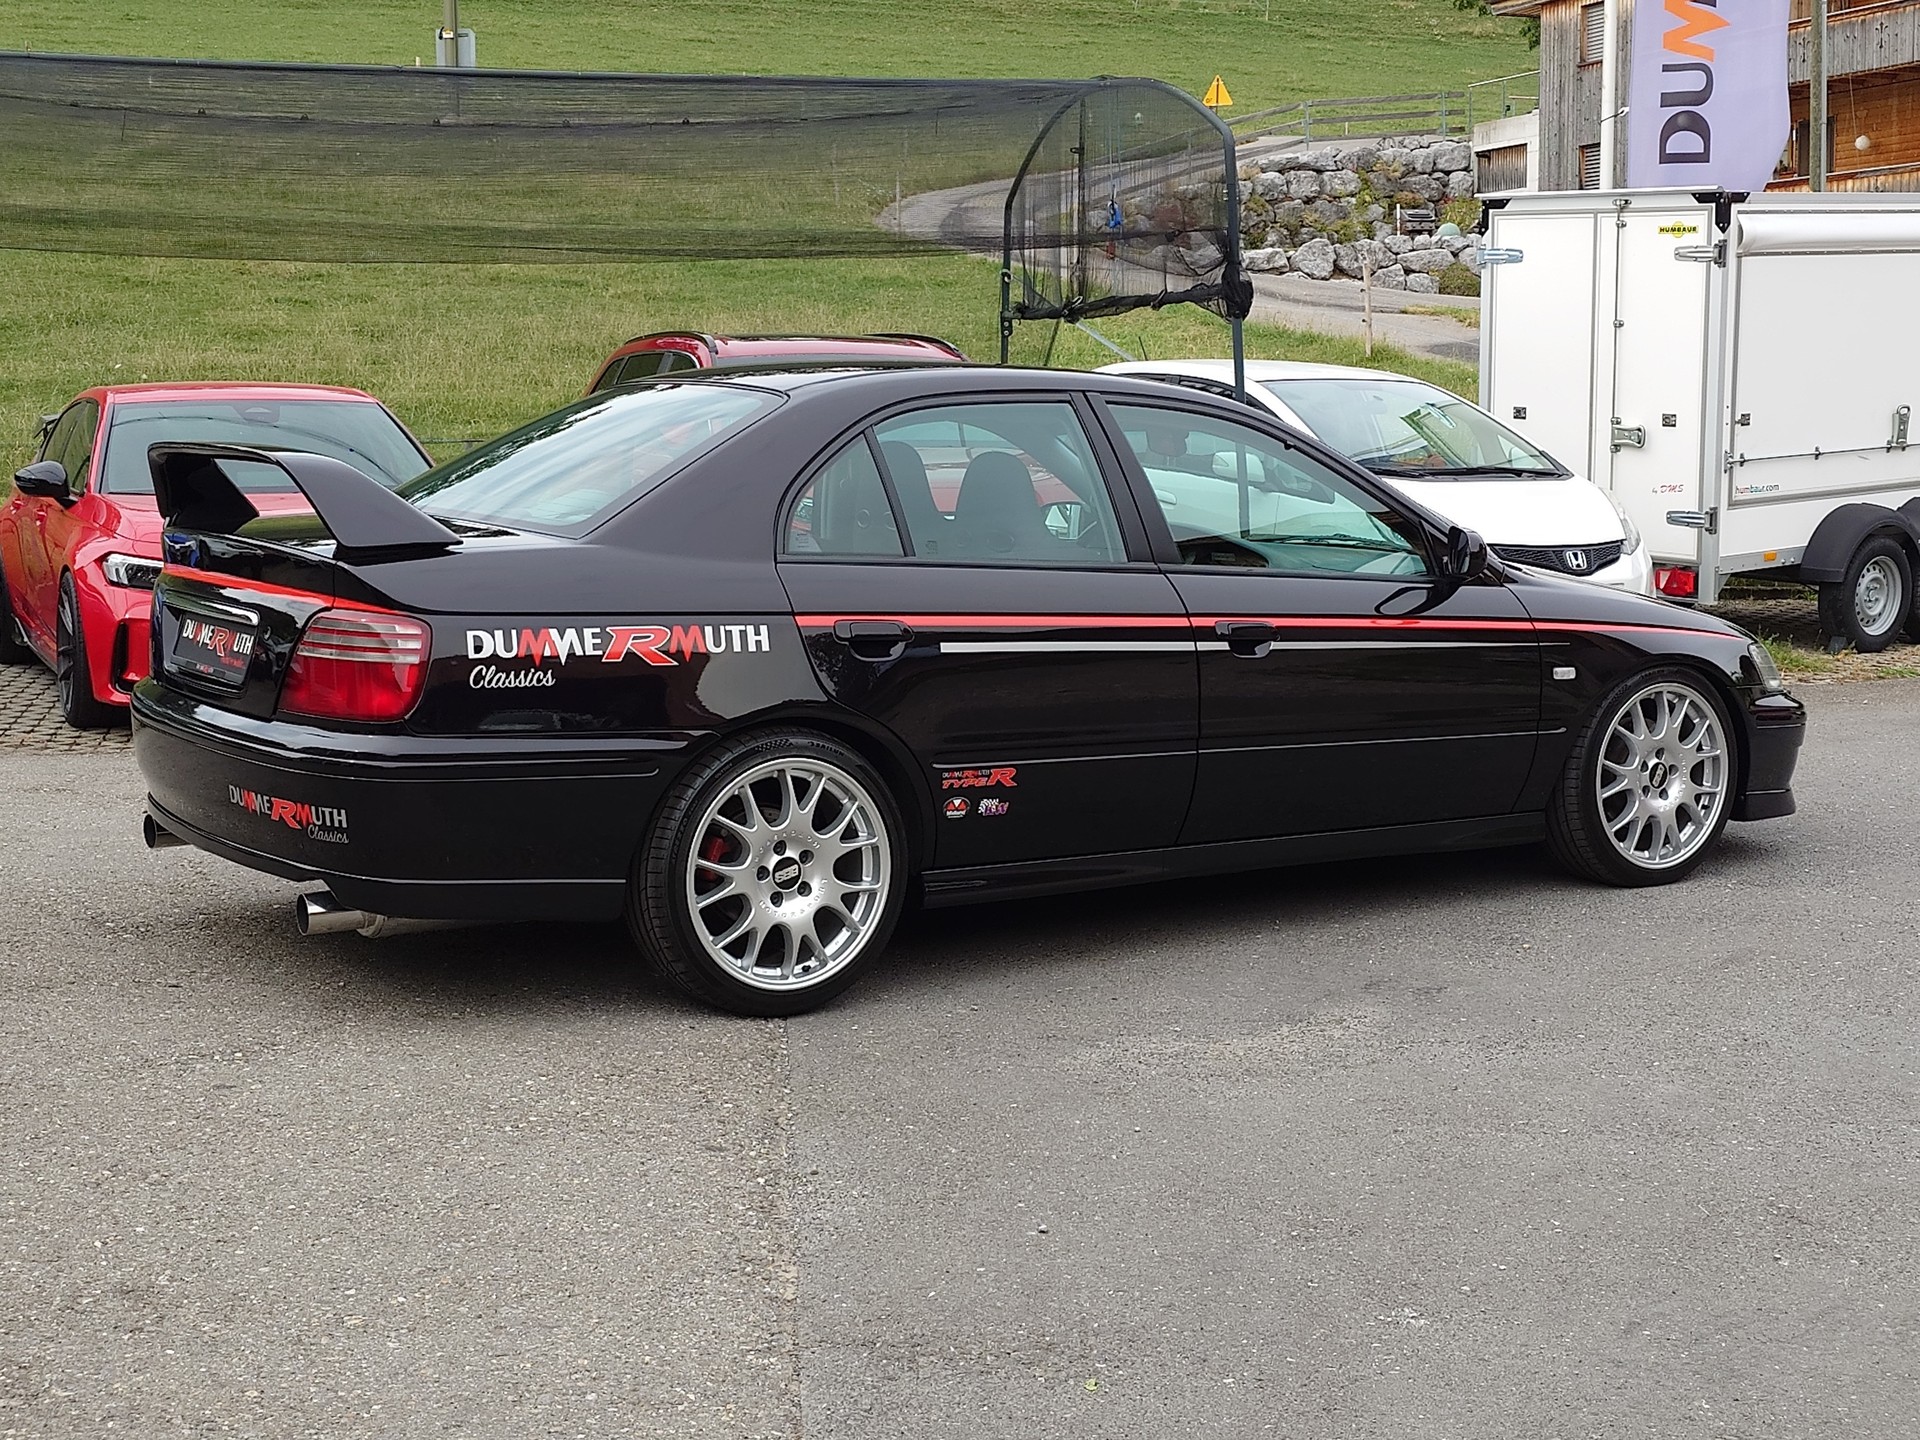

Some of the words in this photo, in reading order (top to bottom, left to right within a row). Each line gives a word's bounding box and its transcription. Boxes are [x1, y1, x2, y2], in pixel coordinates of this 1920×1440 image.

[1659, 0, 1732, 165] DUM
[1735, 484, 1779, 495] humbaur.com
[469, 665, 556, 689] Classics
[942, 777, 988, 790] TYPE
[986, 767, 1018, 788] R
[308, 824, 350, 844] Classics
